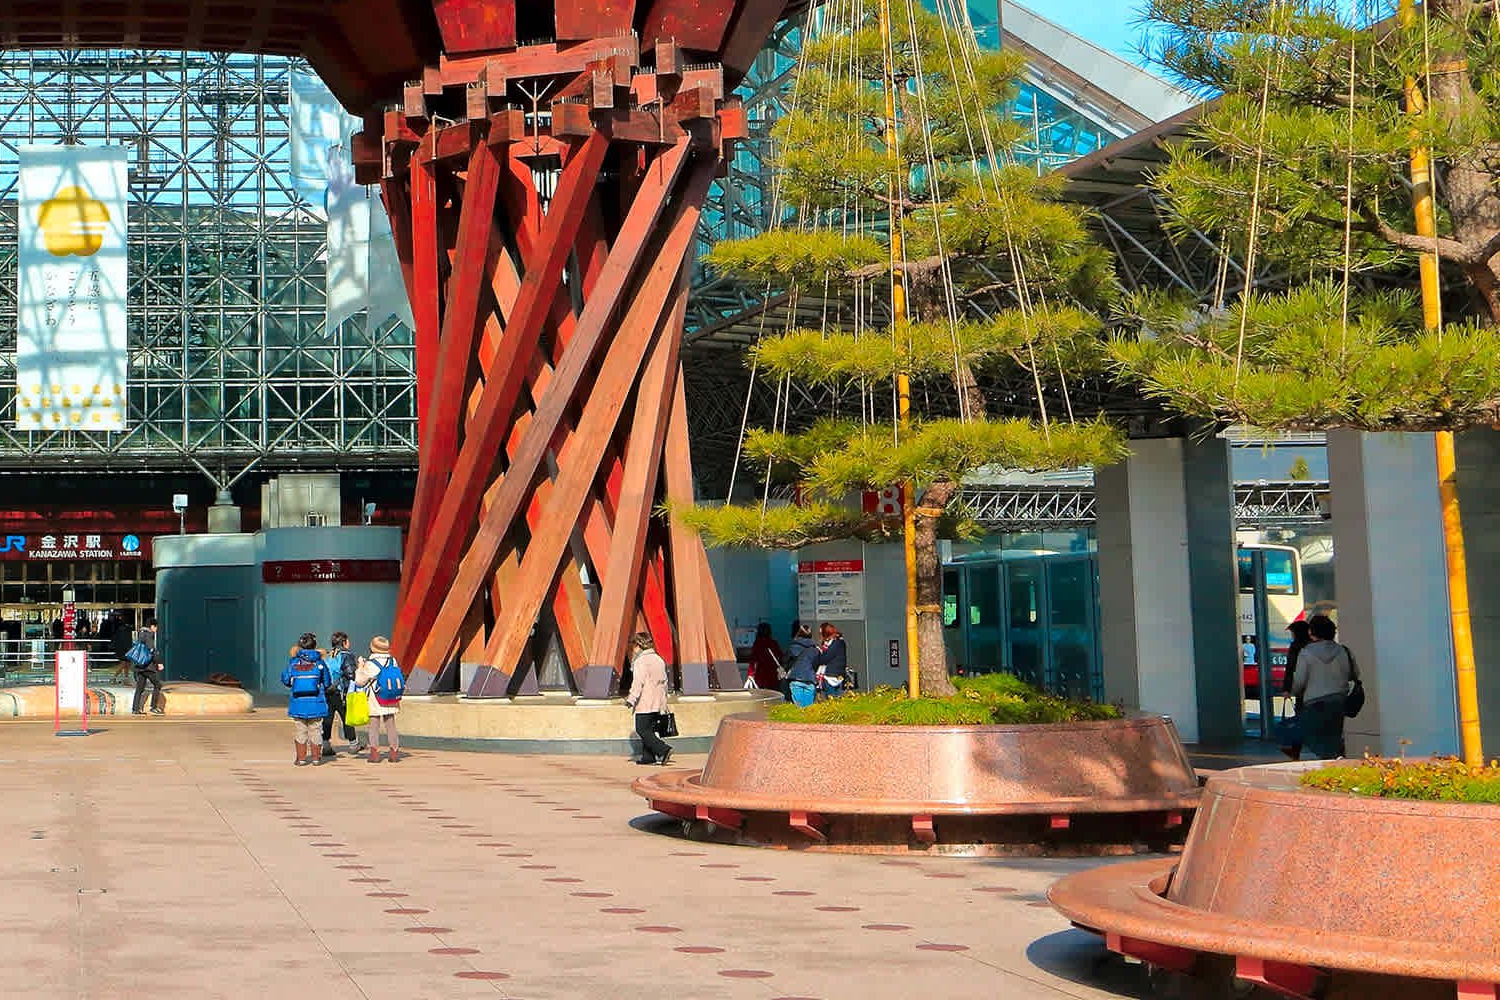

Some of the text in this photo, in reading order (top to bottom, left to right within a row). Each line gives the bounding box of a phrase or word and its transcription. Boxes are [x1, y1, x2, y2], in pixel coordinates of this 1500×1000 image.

[41, 535, 101, 548] 金沢駅
[79, 550, 113, 558] STATION
